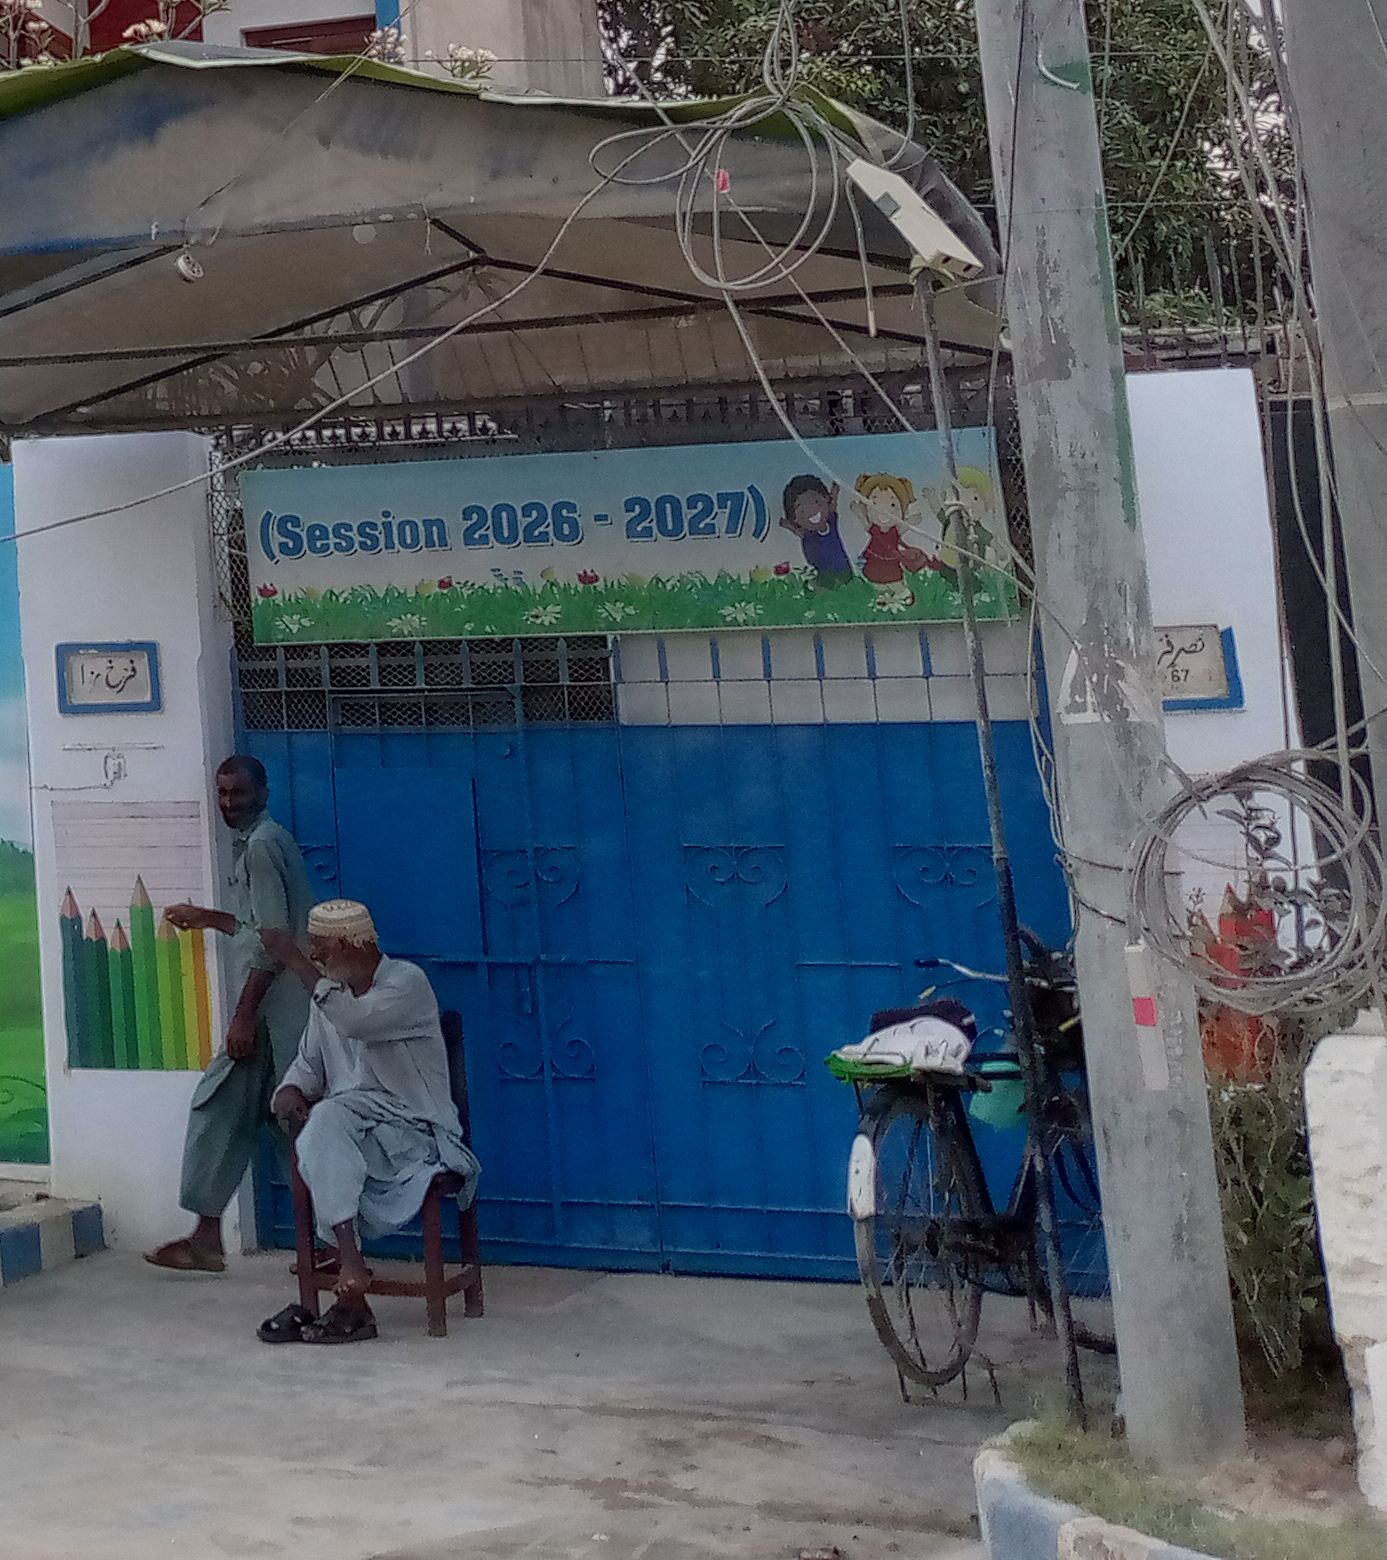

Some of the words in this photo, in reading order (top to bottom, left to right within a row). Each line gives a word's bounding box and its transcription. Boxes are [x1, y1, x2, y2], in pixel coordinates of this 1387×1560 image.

[259, 509, 453, 565] (Session
[461, 500, 585, 551] 2026
[624, 483, 770, 544] 2027)
